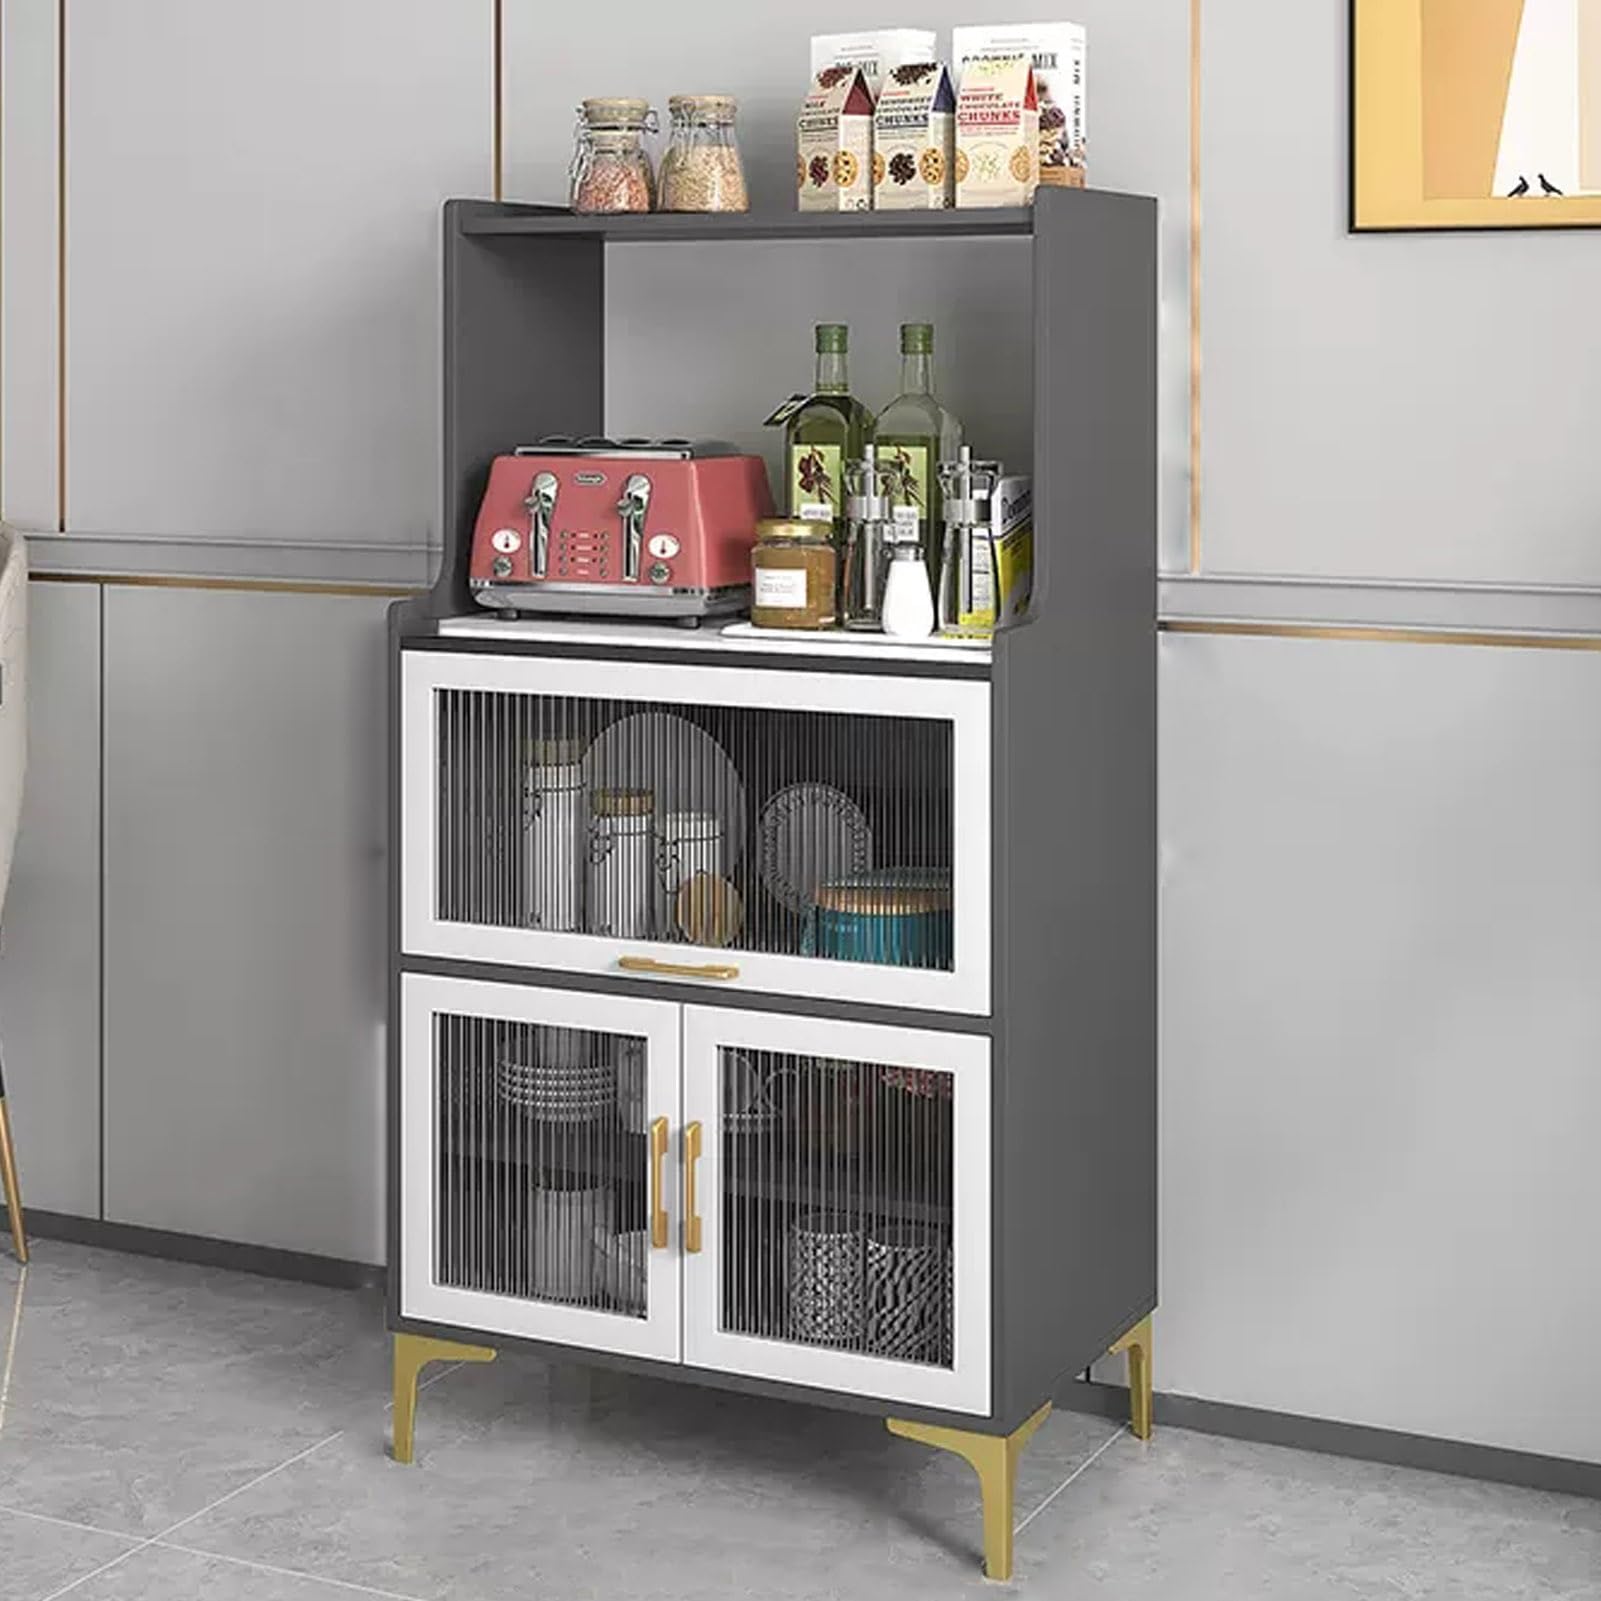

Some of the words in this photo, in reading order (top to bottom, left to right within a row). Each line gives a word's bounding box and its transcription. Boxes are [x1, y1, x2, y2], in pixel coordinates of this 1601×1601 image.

[960, 93, 1003, 101] WHITE
[958, 101, 1020, 110] CHOCOLATE
[875, 113, 929, 125] CHUNKS
[957, 110, 1020, 121] CHUNKS
